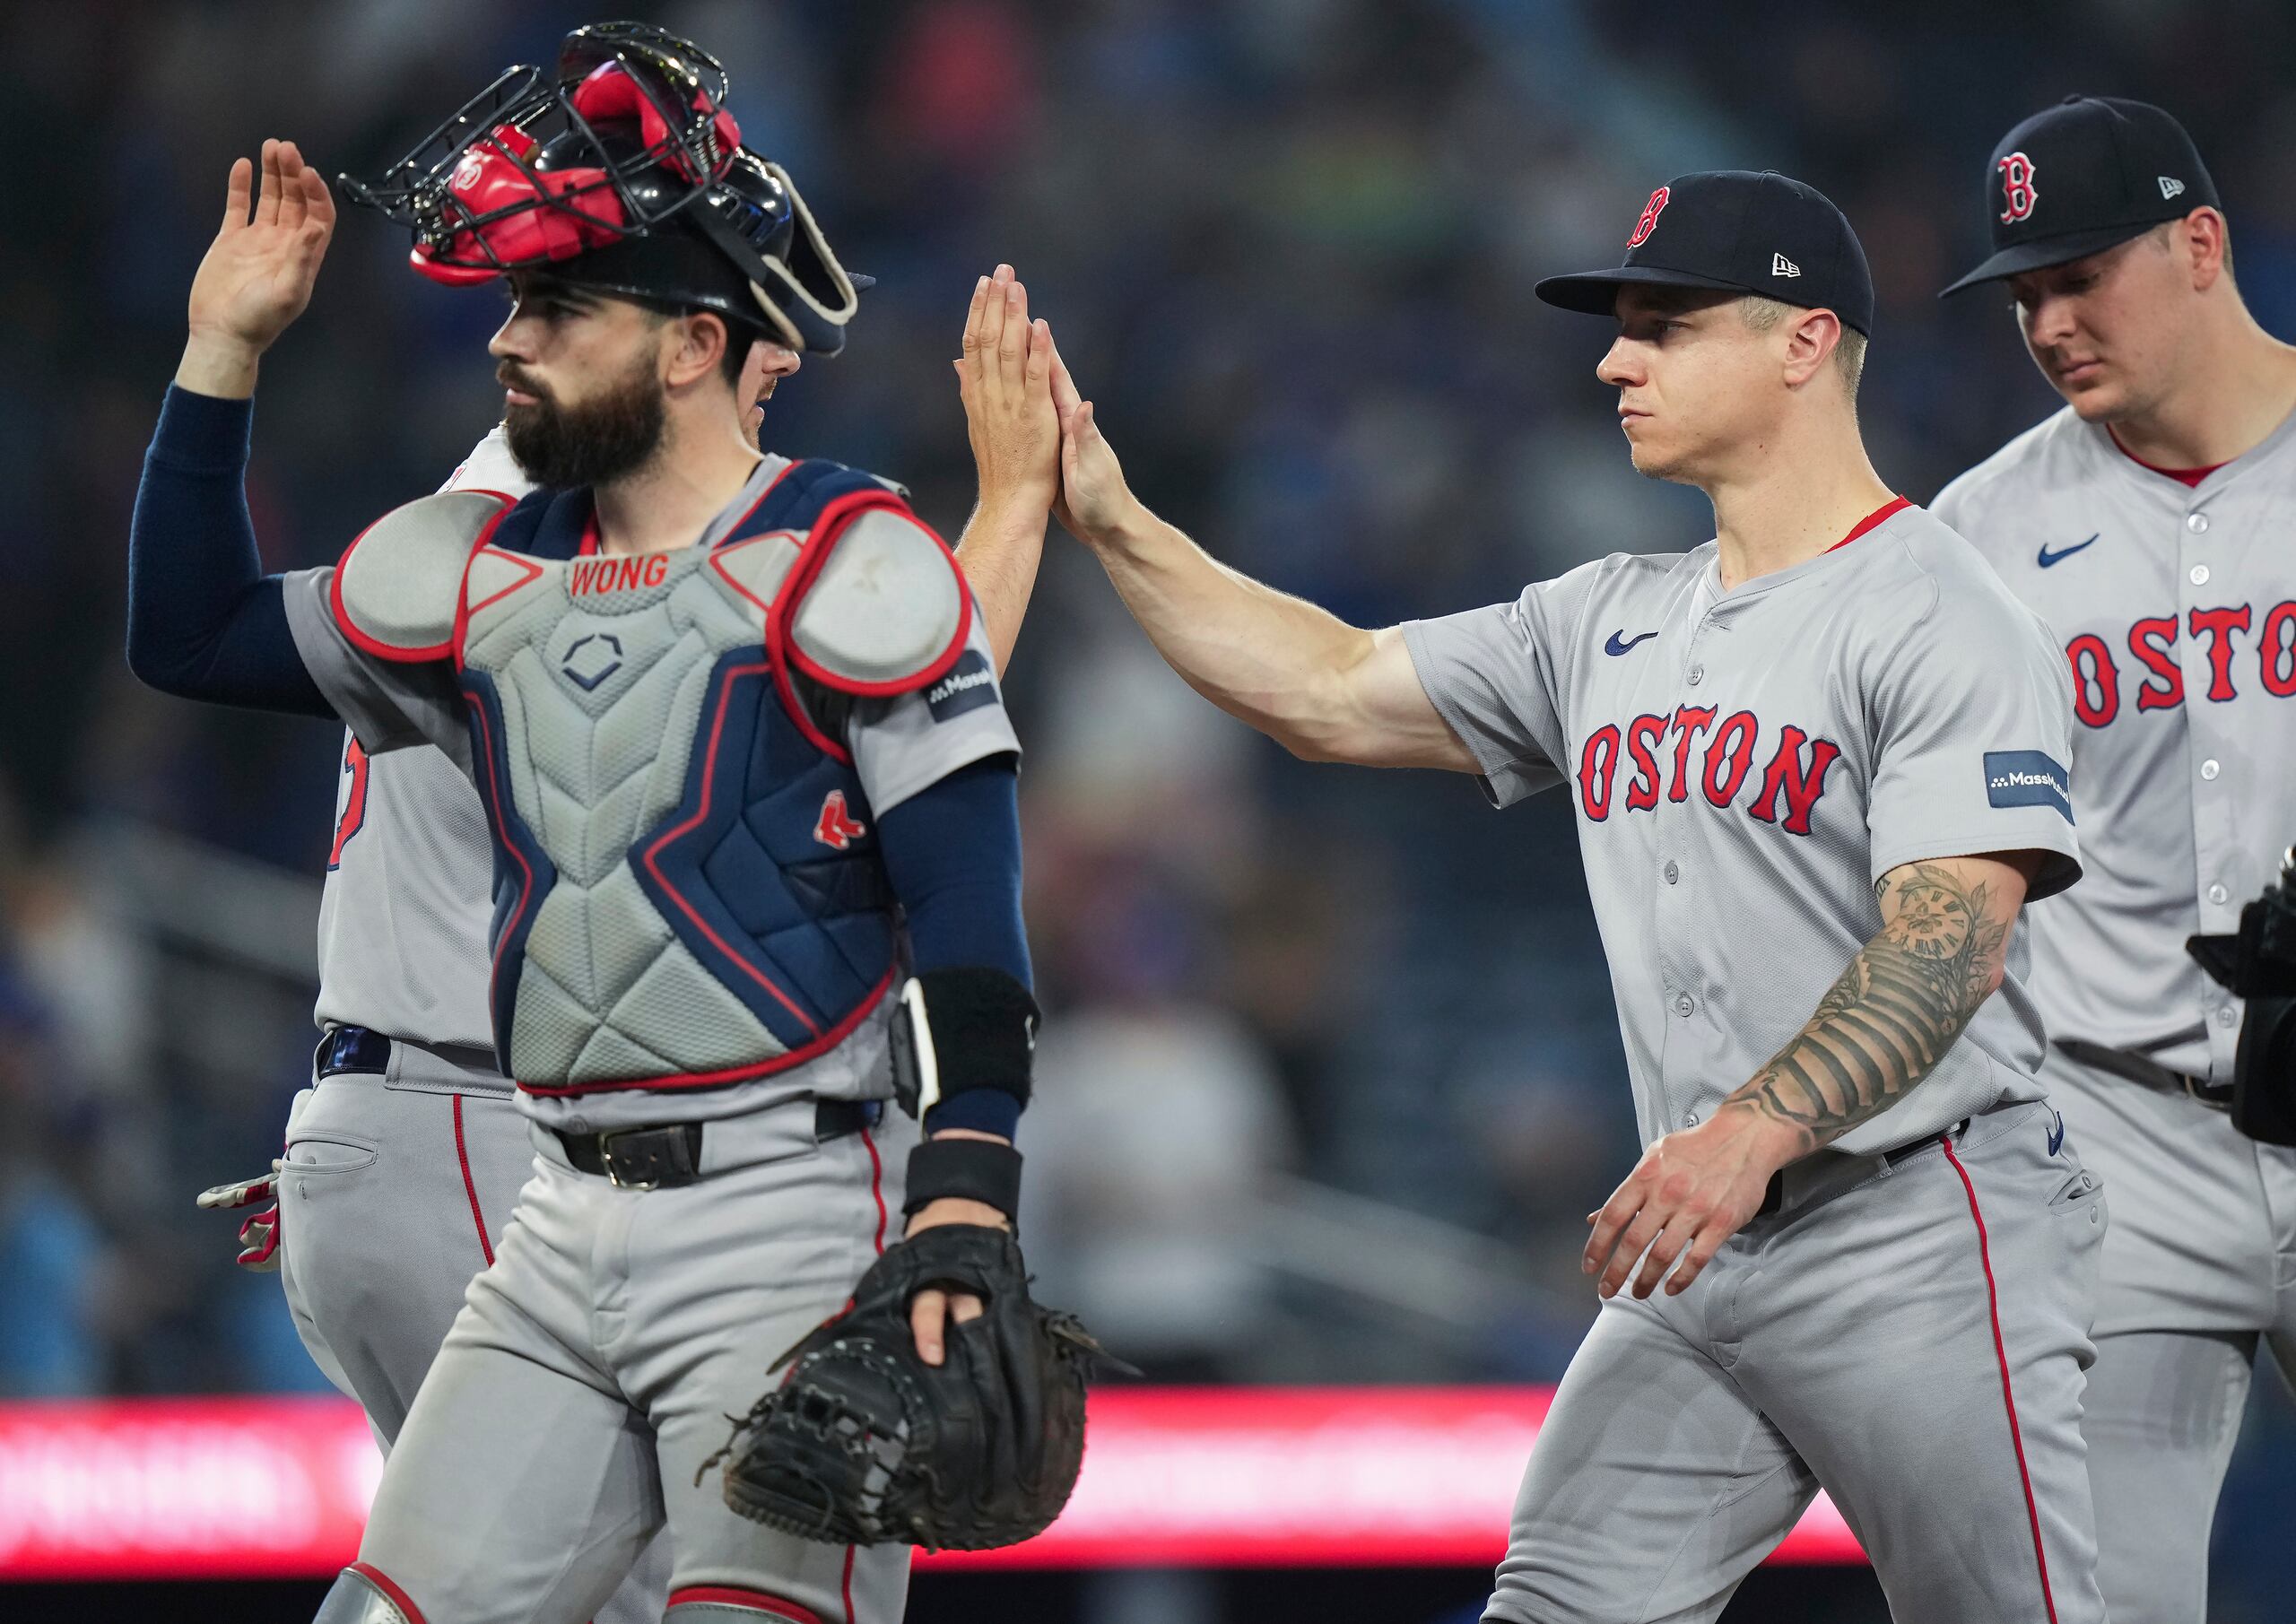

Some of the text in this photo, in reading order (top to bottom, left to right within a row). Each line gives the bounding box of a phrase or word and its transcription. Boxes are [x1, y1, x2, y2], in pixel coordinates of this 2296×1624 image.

[1626, 186, 1670, 249] B
[1997, 152, 2039, 225] B
[571, 552, 668, 596] WONG
